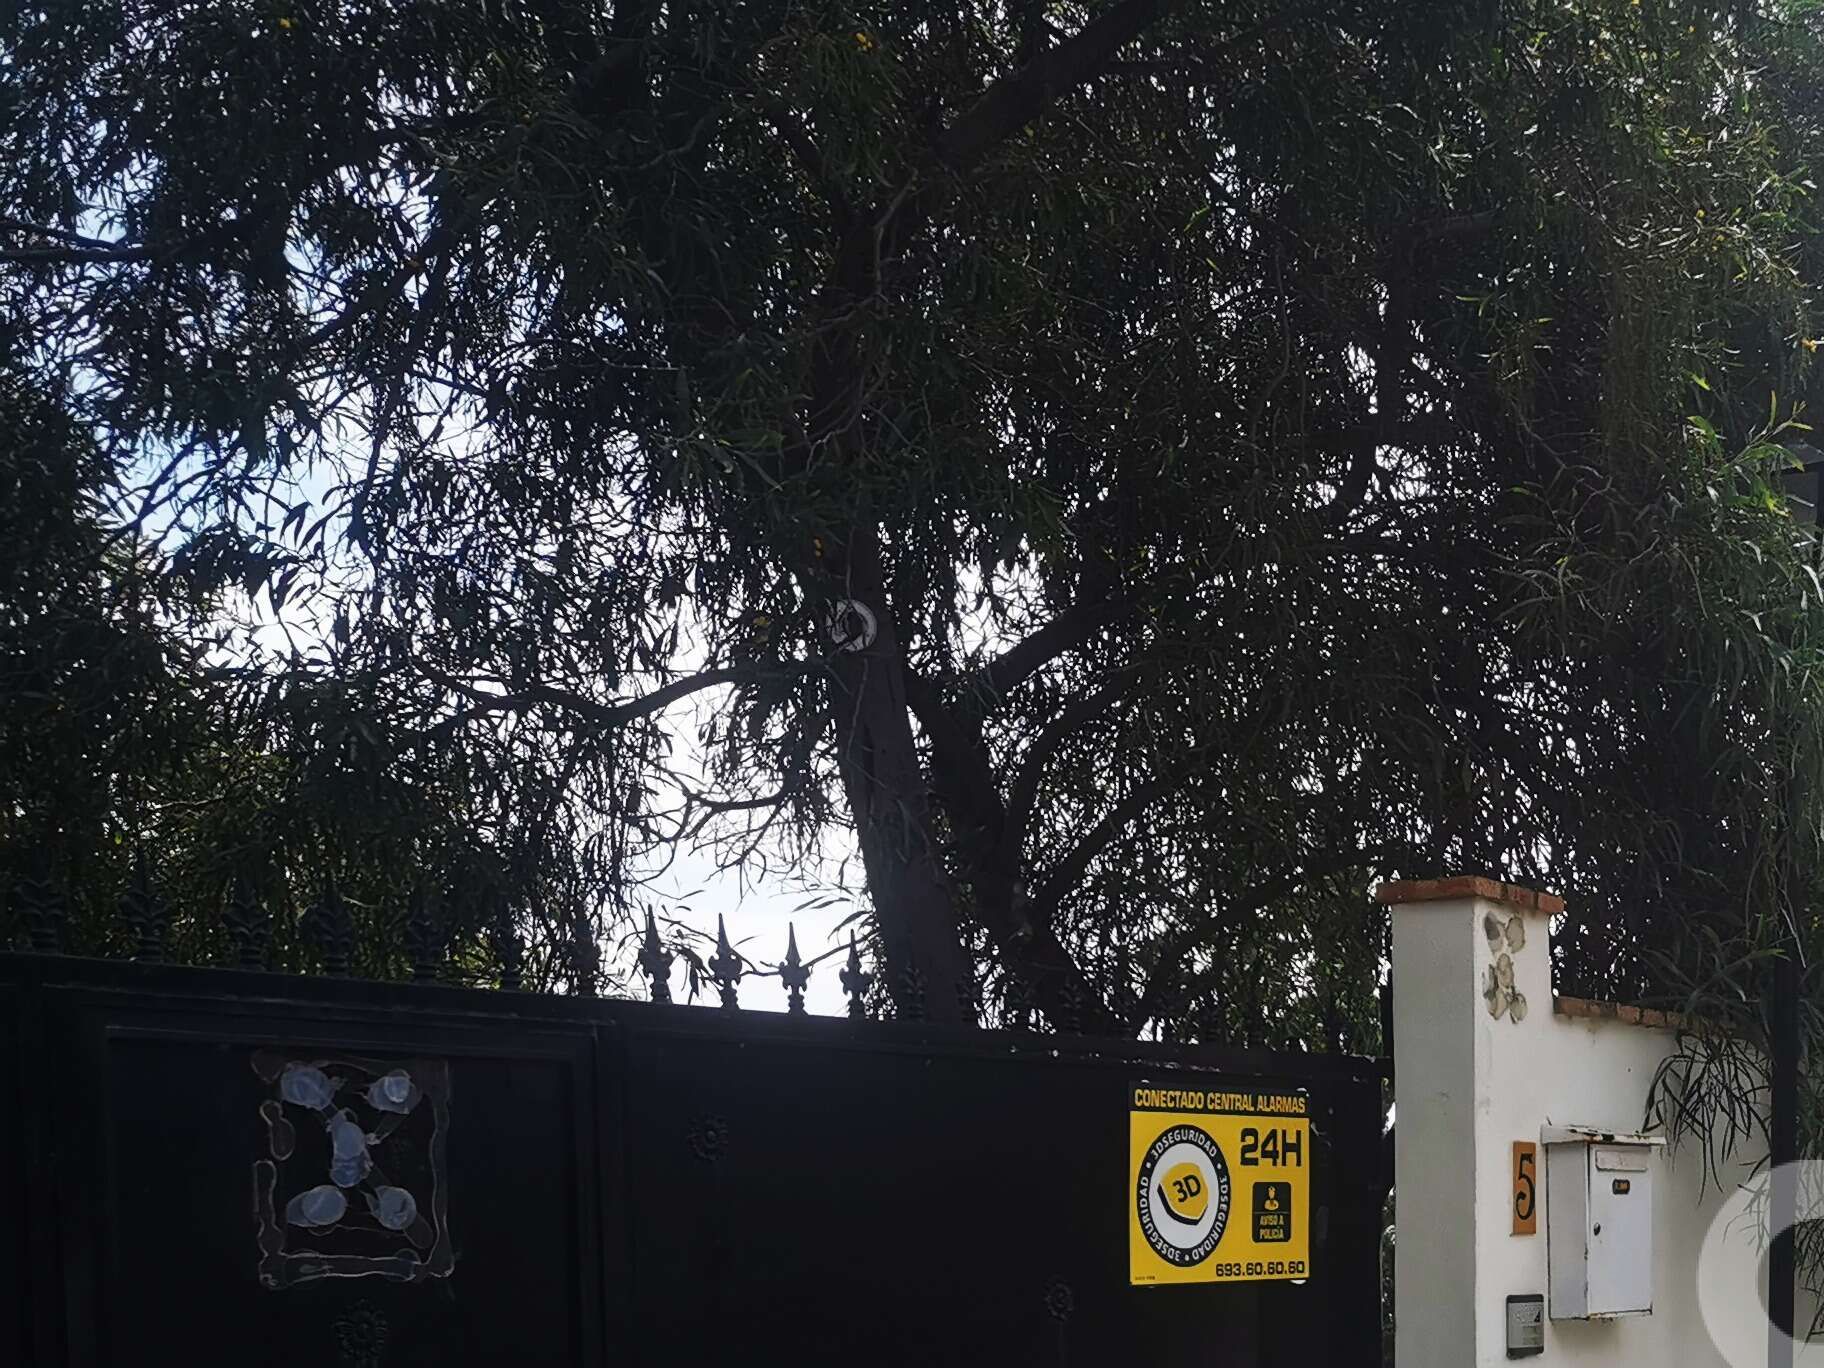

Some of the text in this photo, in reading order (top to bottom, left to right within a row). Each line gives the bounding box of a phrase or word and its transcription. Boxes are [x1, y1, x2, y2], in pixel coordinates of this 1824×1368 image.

[1135, 1089, 1306, 1113] CONECTADO CENTRAL ALARMAS
[1240, 1127, 1302, 1167] 24H
[1172, 1174, 1201, 1203] 3D
[1515, 1153, 1536, 1221] 5
[1216, 1261, 1305, 1277] 693.60.60.60
